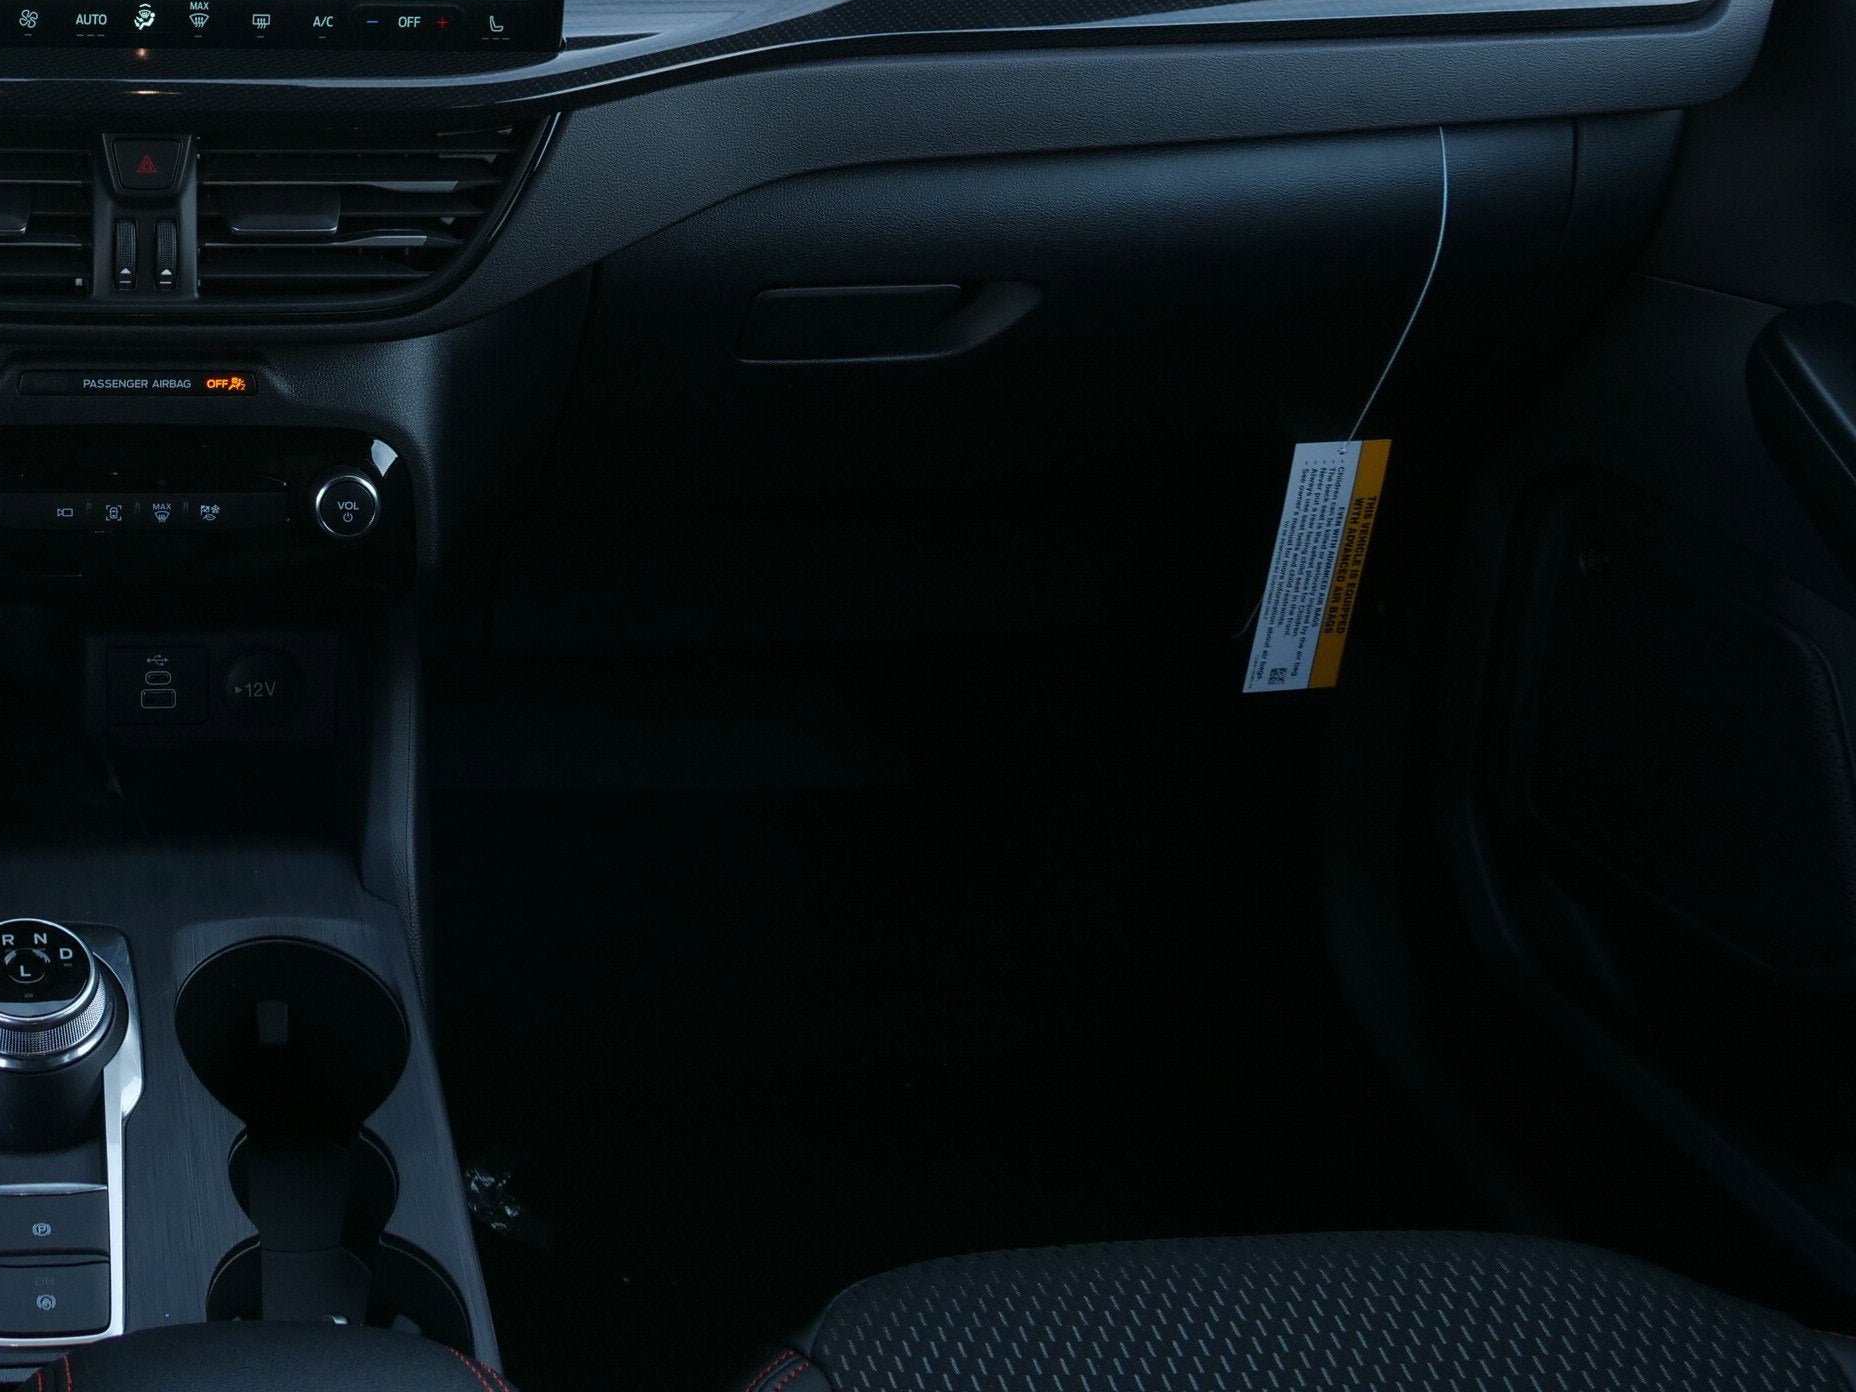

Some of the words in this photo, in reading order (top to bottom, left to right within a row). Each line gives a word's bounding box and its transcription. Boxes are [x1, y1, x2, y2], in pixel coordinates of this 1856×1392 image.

[190, 2, 209, 10] MAX
[76, 13, 107, 26] AUTO
[312, 15, 334, 29] A/C
[398, 15, 421, 28] OFF
[83, 379, 149, 389] PASSENGER
[152, 379, 192, 389] AIRBAG
[206, 379, 229, 389] OFF
[152, 502, 172, 511] MAX
[337, 501, 360, 511] VOL
[1348, 497, 1364, 524] WITH
[1361, 495, 1377, 520] THIS
[1351, 522, 1371, 566] VEHICLE
[1335, 526, 1358, 582] ADVANCED
[1348, 568, 1360, 579] IS
[1330, 585, 1344, 603] AIR
[1336, 581, 1358, 634] EQUIPPED
[1323, 606, 1340, 634] BAGS
[245, 681, 277, 697] 12V
[1, 934, 15, 946] R
[33, 933, 48, 944] N
[59, 948, 73, 960] D
[19, 965, 32, 977] L
